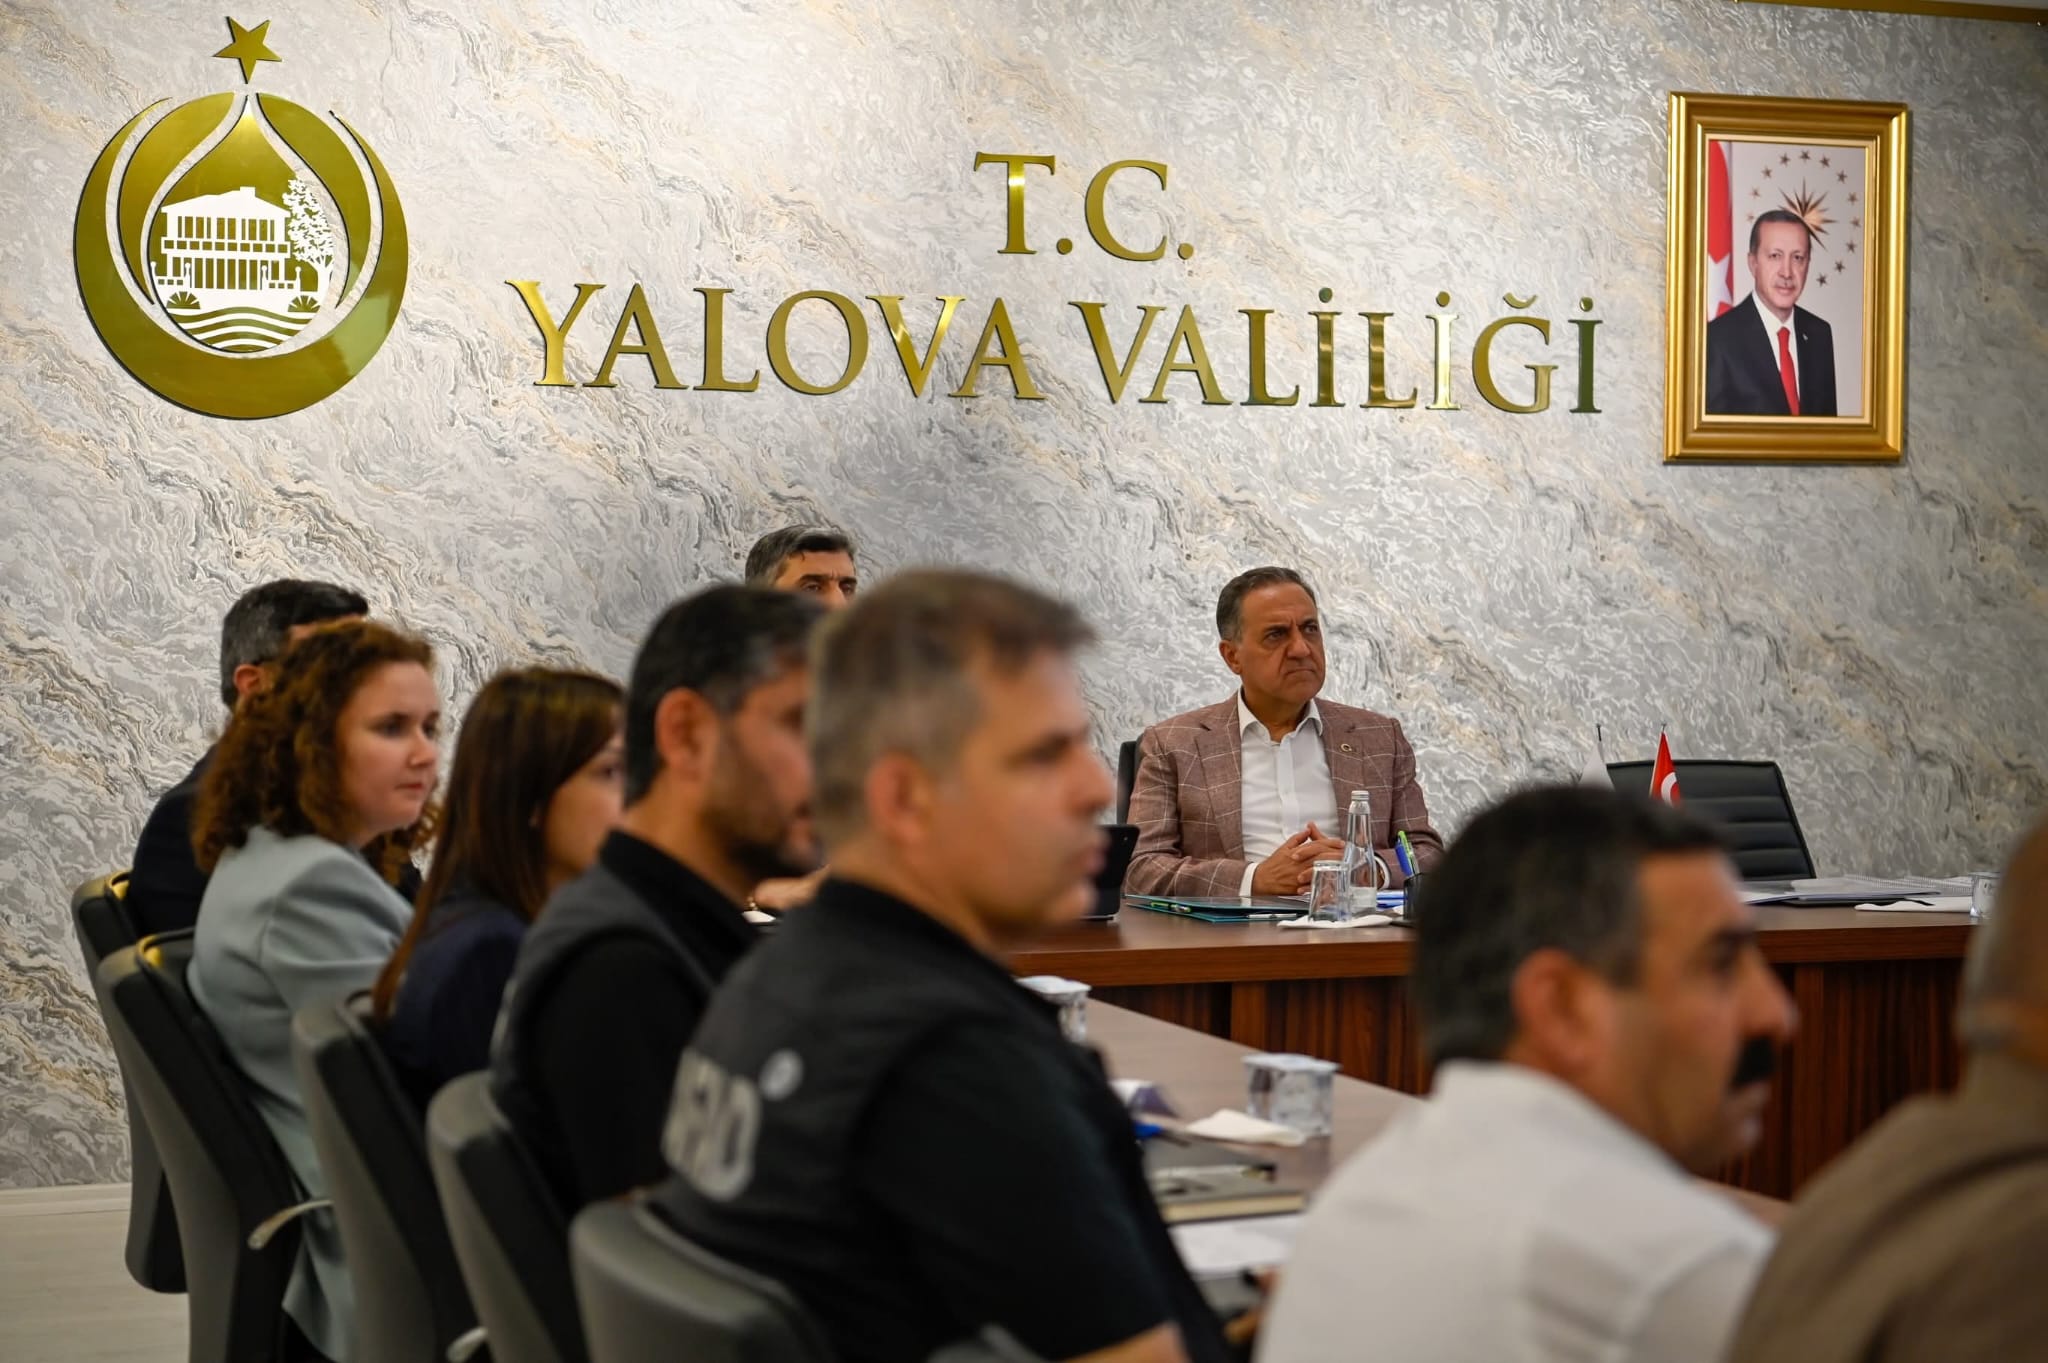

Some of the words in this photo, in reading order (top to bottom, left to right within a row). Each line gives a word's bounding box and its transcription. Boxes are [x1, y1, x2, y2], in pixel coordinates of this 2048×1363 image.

[973, 150, 1194, 262] T.C.
[504, 279, 1048, 400] YALOVA
[1068, 287, 1603, 414] VALİLİĞİ
